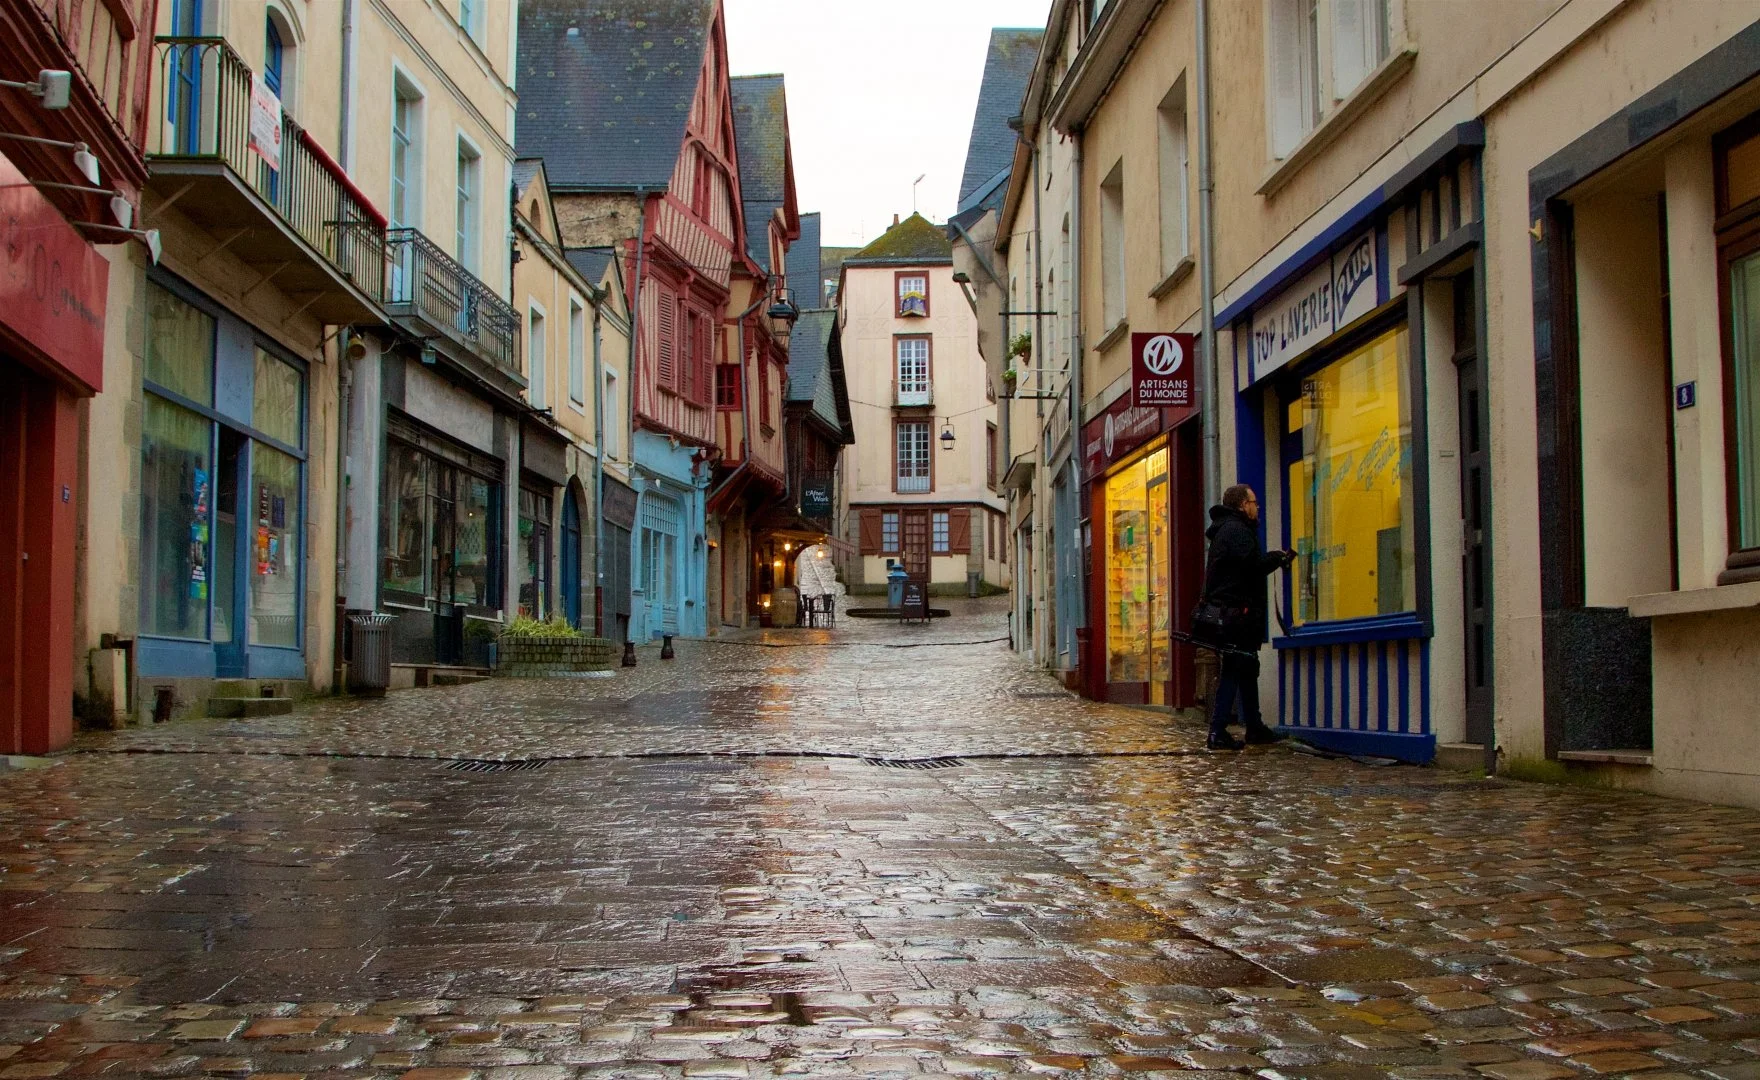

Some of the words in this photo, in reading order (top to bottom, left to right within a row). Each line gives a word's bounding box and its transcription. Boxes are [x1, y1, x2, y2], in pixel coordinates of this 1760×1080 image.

[1335, 241, 1372, 311] PLUS
[1255, 318, 1276, 364] TOP
[1280, 282, 1330, 351] LAVERIE
[1139, 379, 1188, 389] ARTISANS
[1139, 389, 1152, 398] DU
[1154, 389, 1188, 398] MONDE
[1682, 388, 1688, 403] 8
